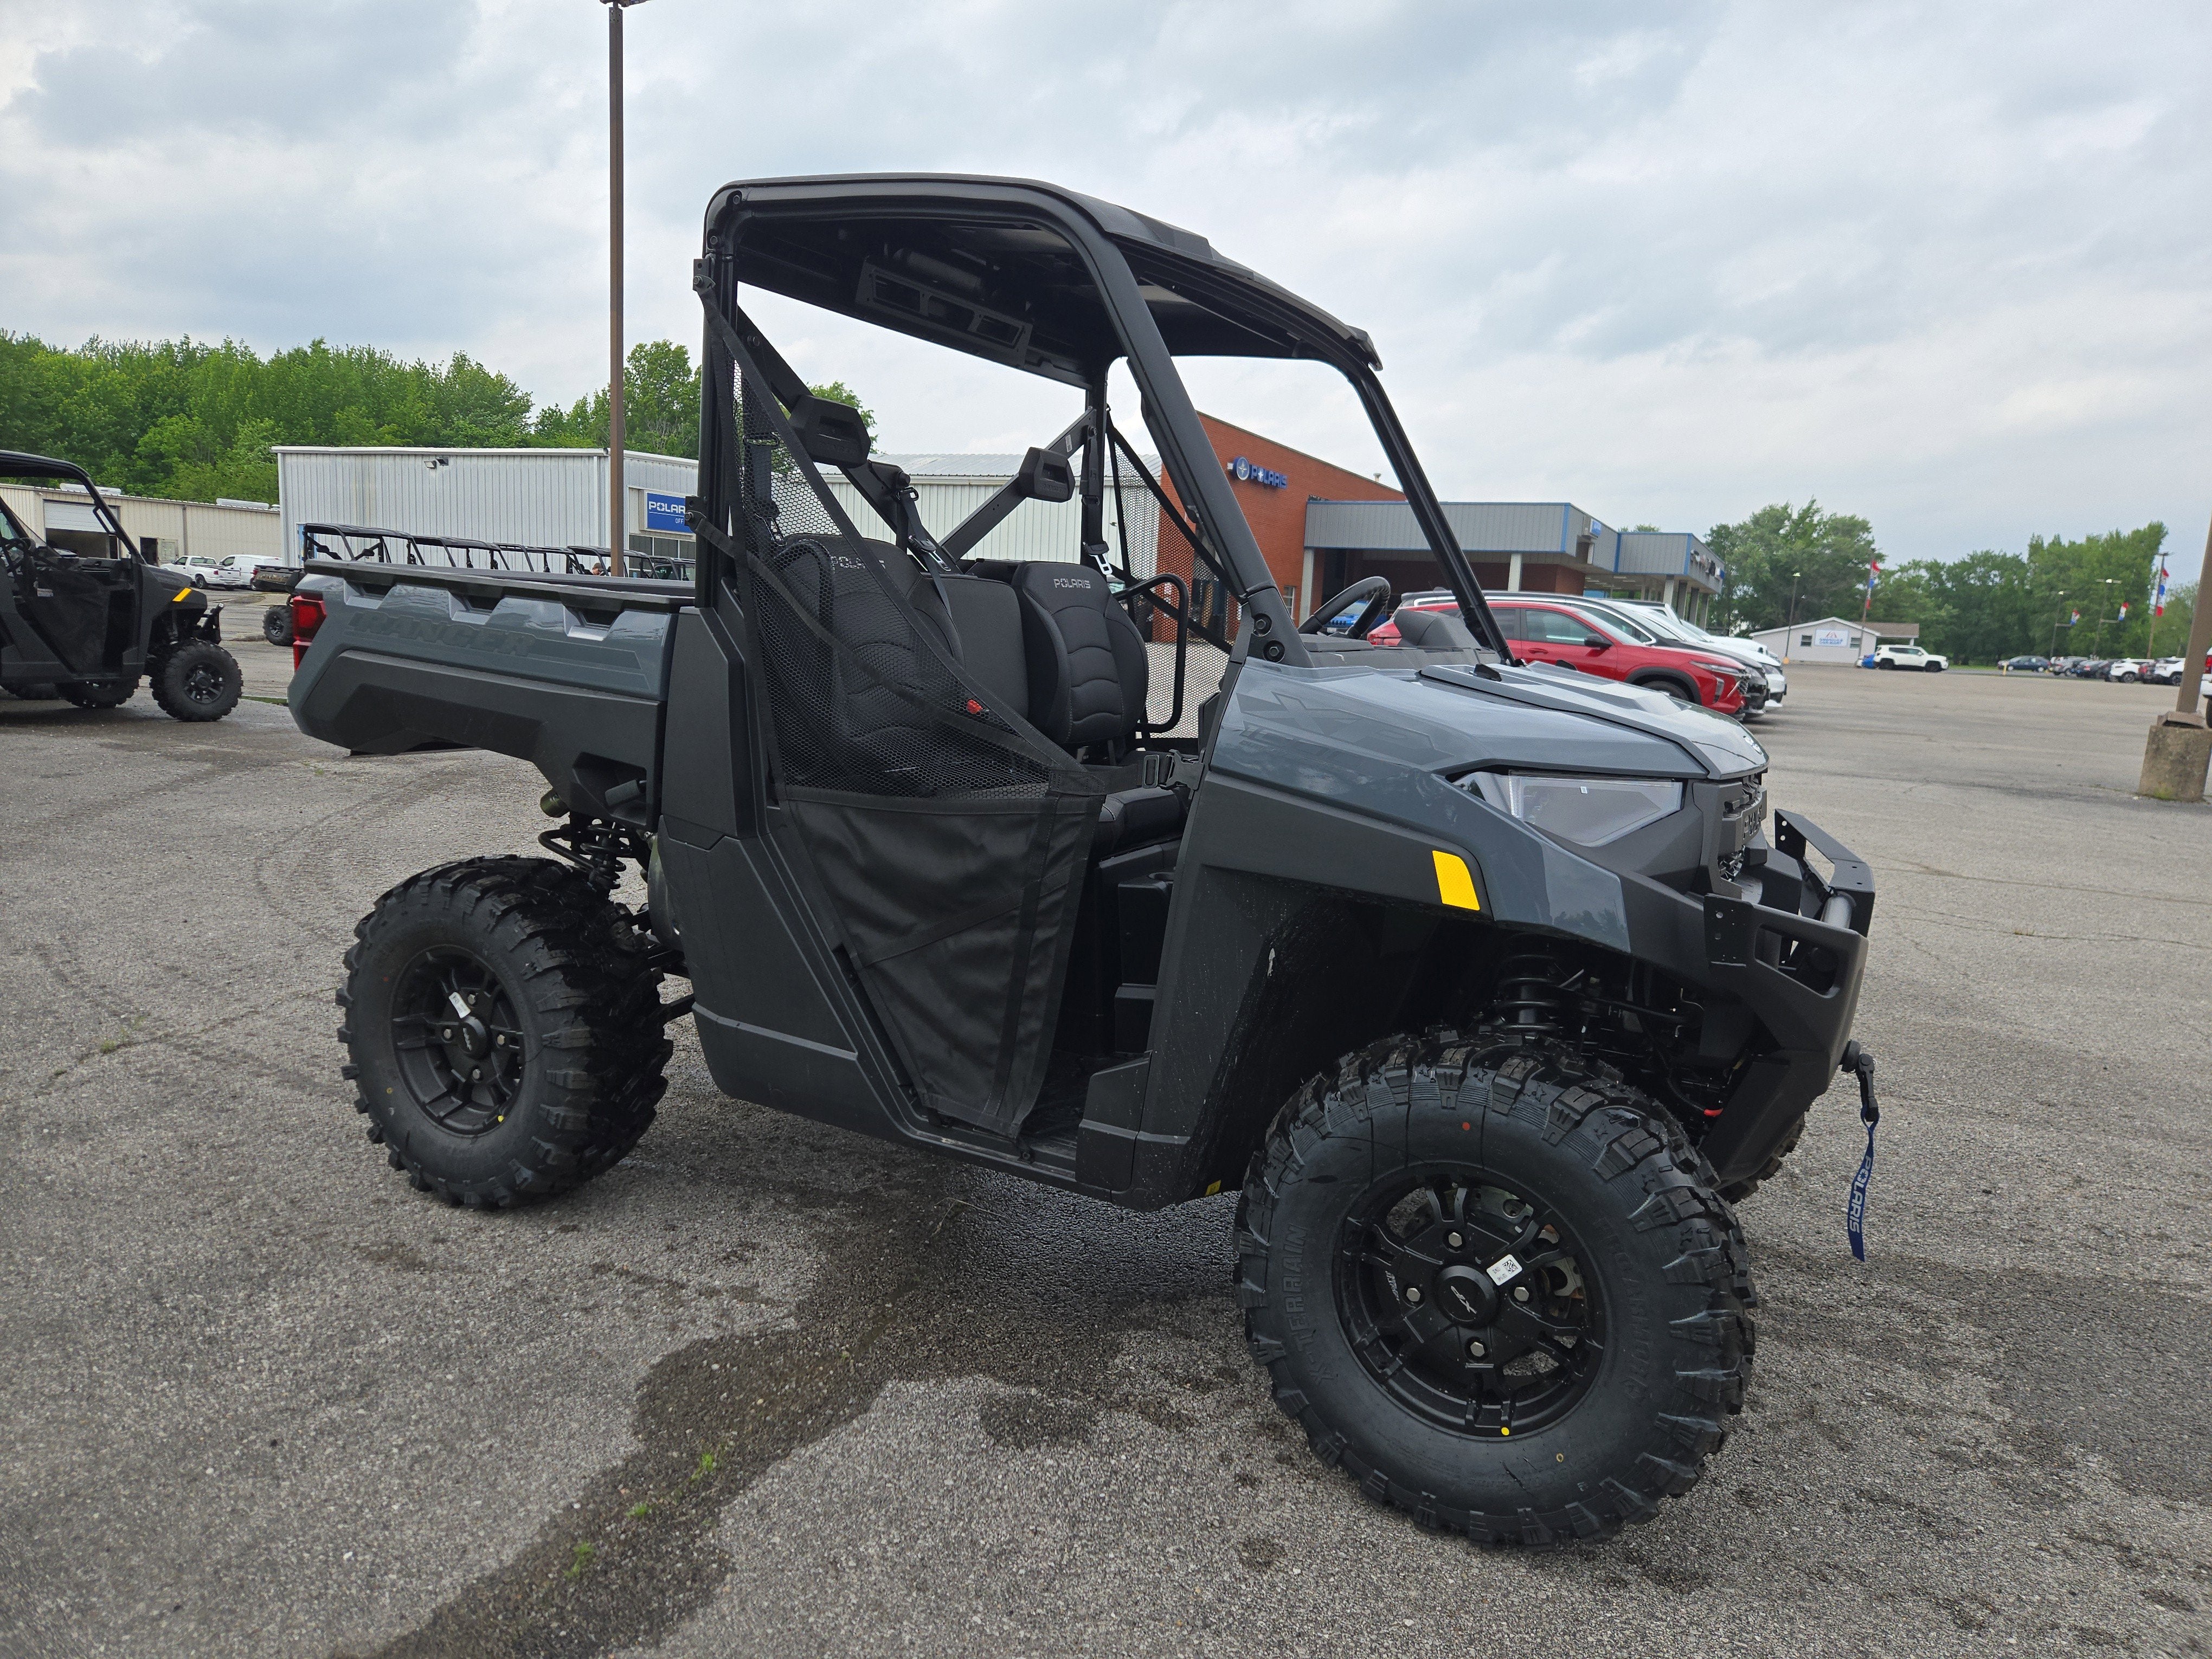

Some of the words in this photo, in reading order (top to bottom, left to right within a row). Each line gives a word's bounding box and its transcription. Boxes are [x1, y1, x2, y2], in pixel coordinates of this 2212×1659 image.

[1250, 464, 1287, 489] POLARIS
[649, 501, 685, 514] POLAR
[1053, 578, 1091, 589] POLARIS
[1850, 1155, 1872, 1233] POLARIS
